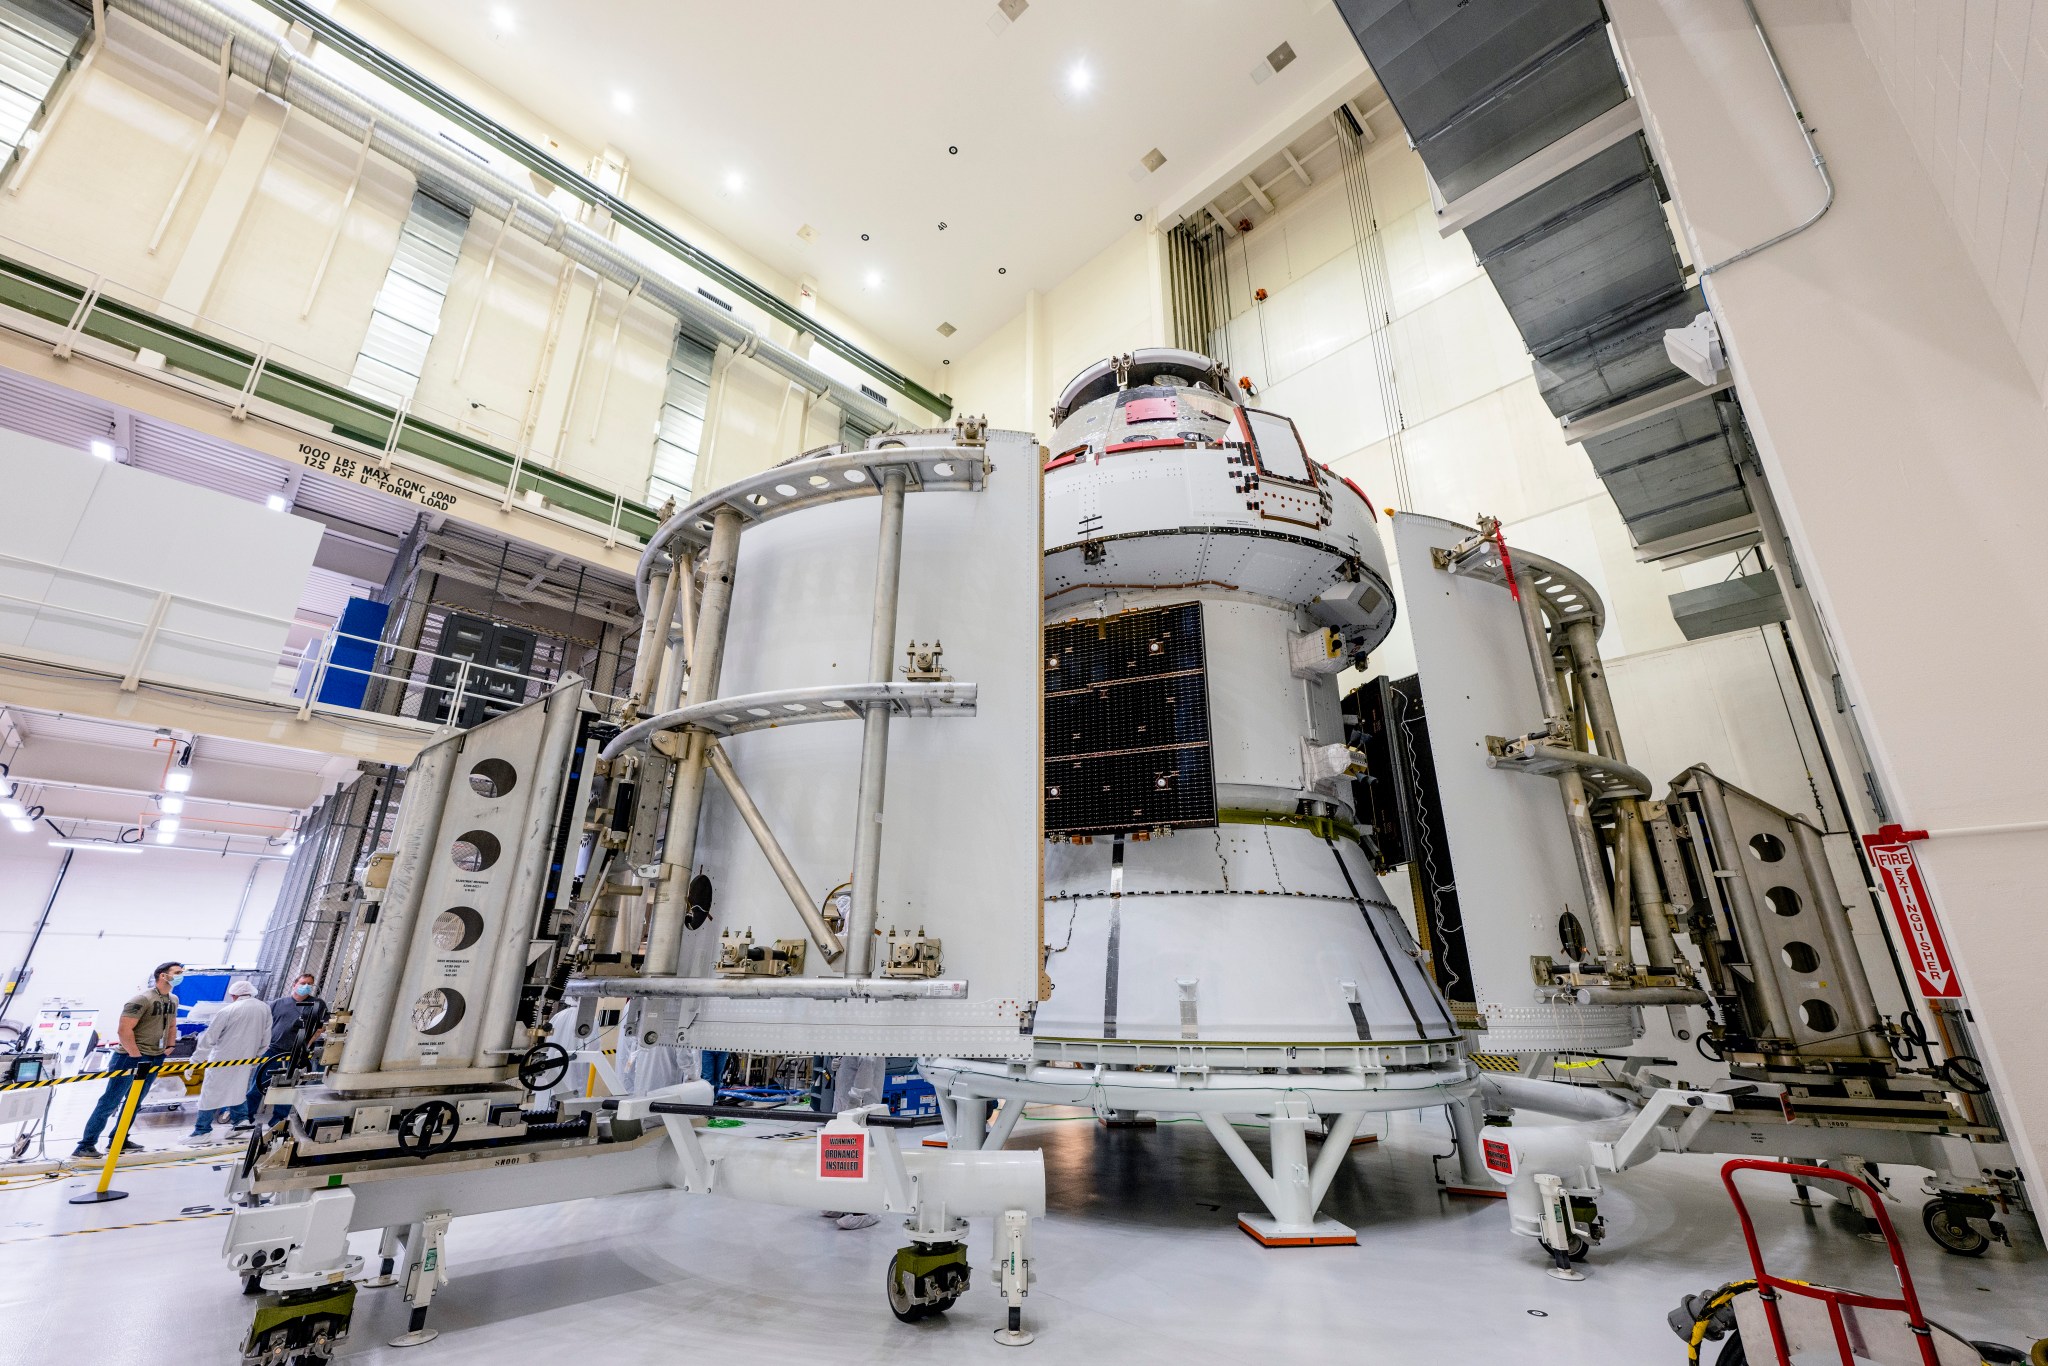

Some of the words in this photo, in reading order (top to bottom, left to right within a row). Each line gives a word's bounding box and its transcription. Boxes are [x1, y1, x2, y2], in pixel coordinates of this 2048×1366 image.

[298, 443, 331, 461] 1000
[335, 456, 357, 470] LBS
[362, 465, 391, 482] MAX
[397, 477, 426, 494] CONC
[304, 455, 326, 470] 125
[332, 466, 355, 479] PSF
[360, 474, 413, 500] UFORM
[420, 495, 449, 511] LOAD
[1878, 852, 1911, 866] FIRE
[1893, 867, 1942, 980] EXTINGUISHER
[825, 1149, 859, 1159] ORDNANCE
[494, 1157, 520, 1167] SN001
[826, 1160, 859, 1171] INSTALLED
